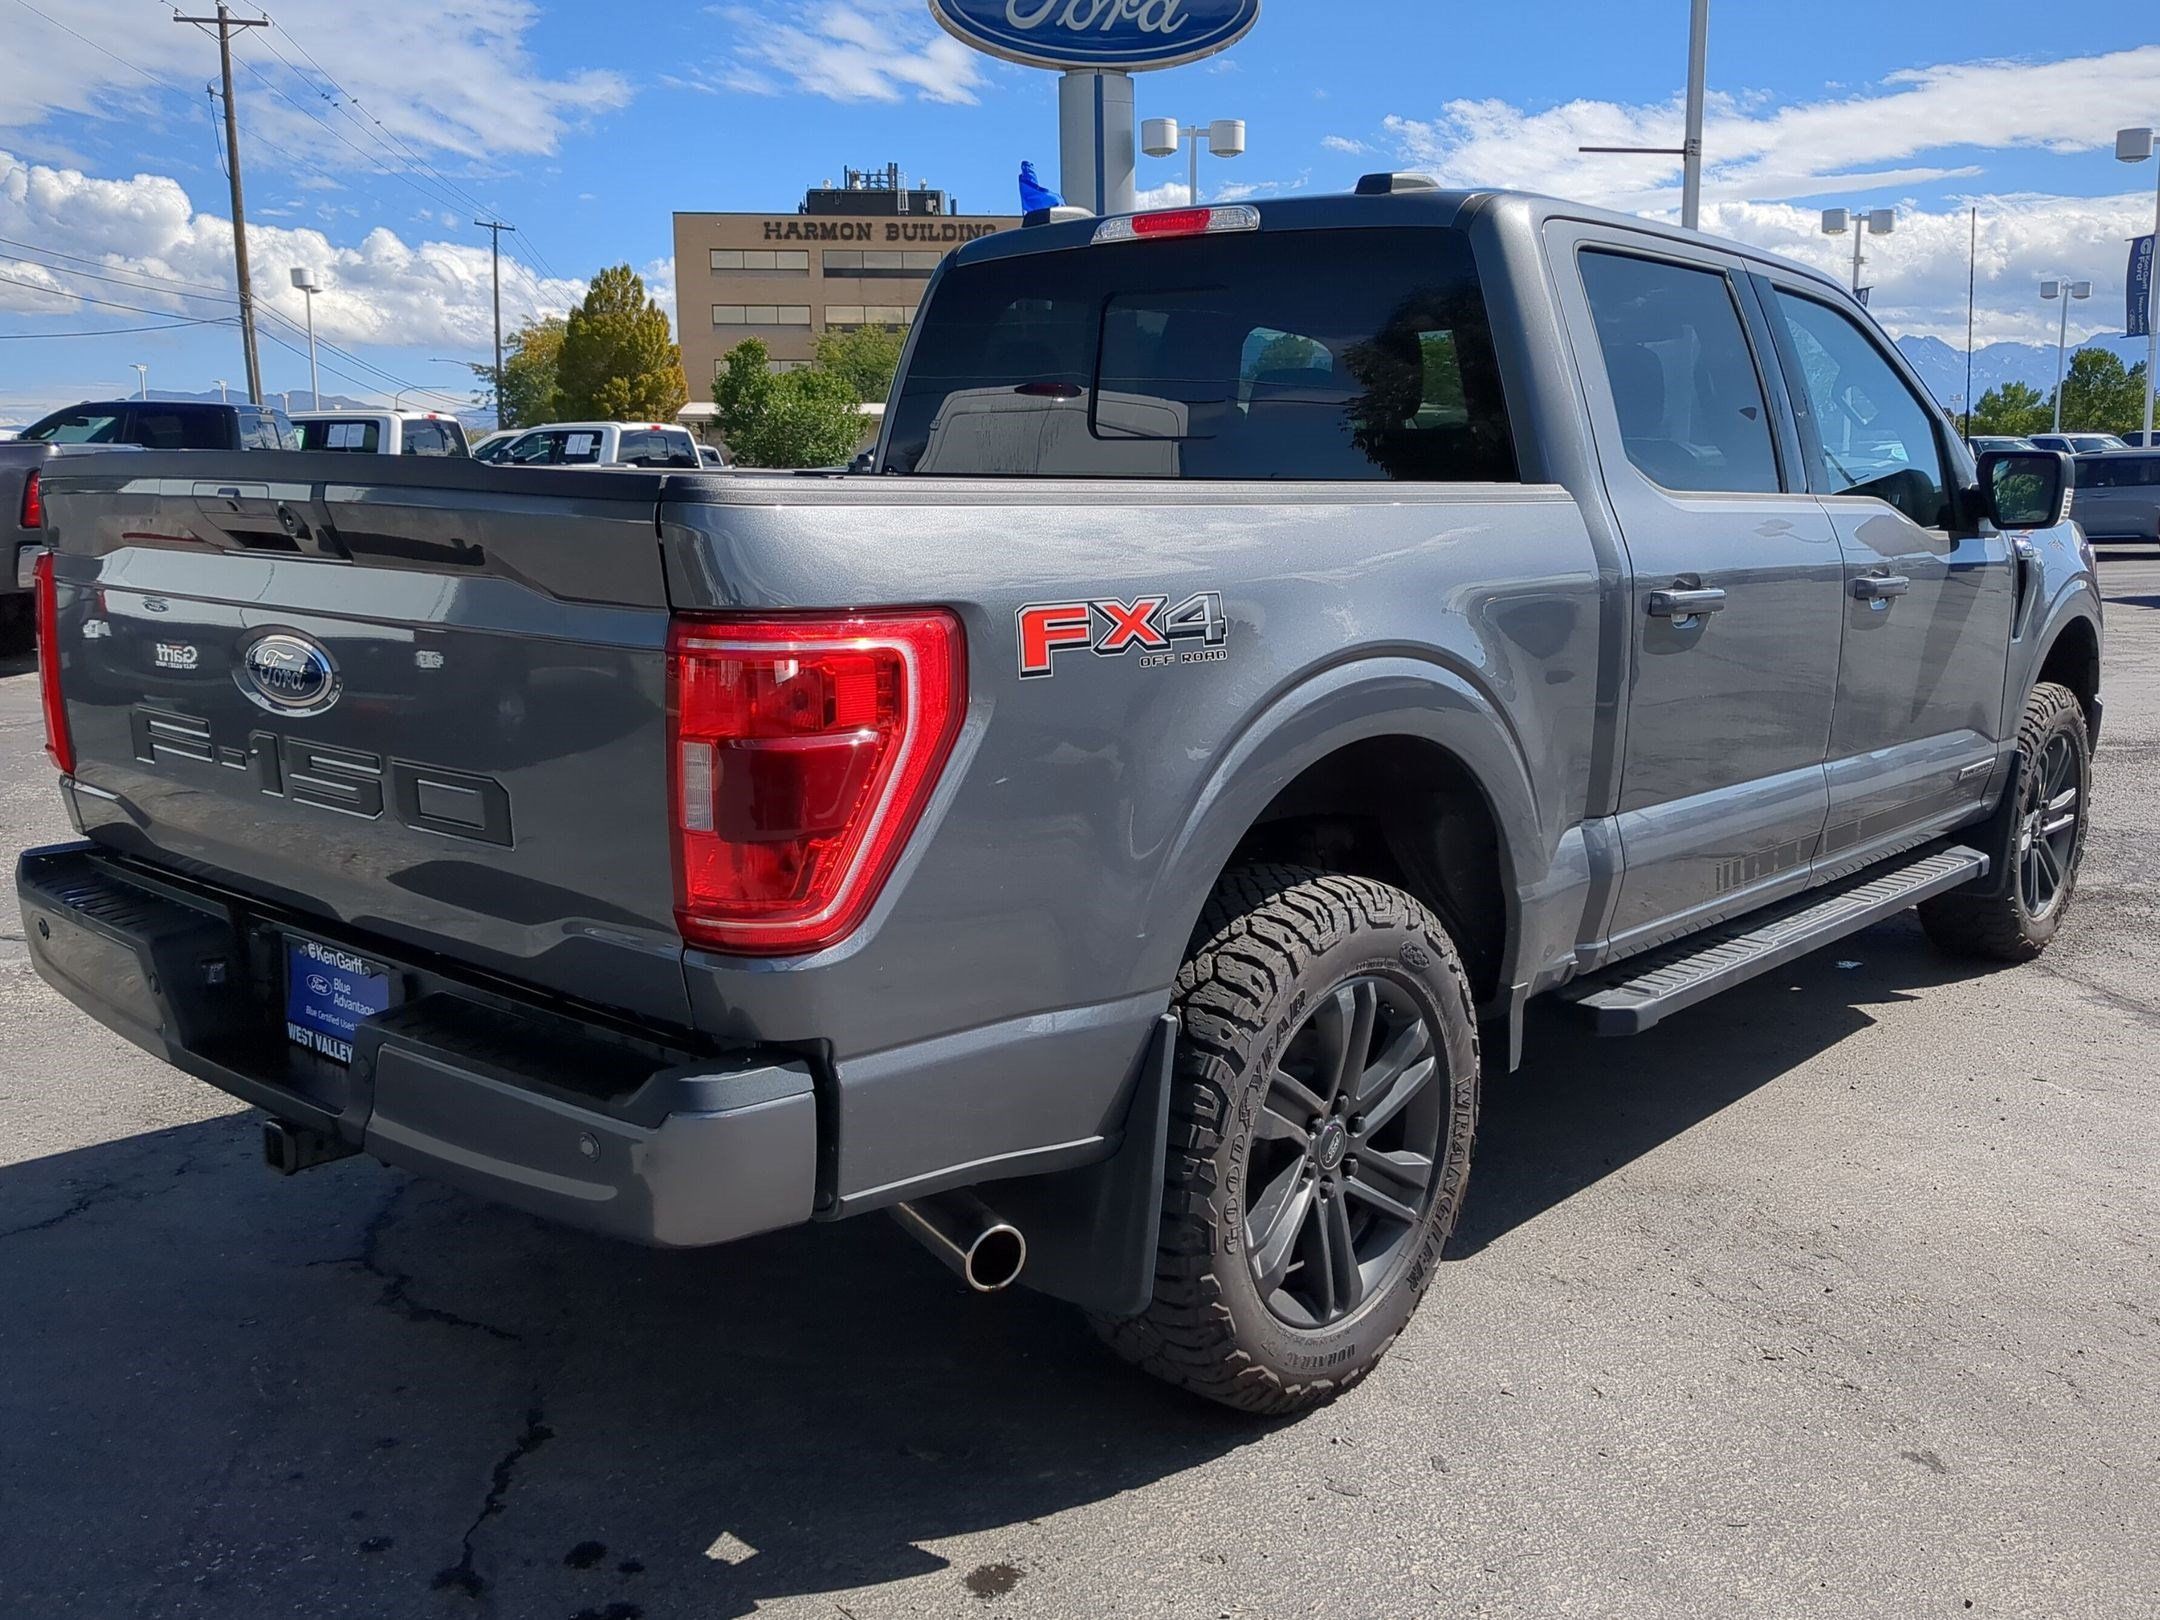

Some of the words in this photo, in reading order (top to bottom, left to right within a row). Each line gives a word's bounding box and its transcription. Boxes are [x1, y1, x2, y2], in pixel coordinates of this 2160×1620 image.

[1005, 0, 1189, 33] ord
[763, 221, 872, 241] HARMON
[885, 223, 996, 242] BUILDING
[2136, 256, 2144, 281] Ford
[1014, 590, 1228, 680] FX4
[259, 649, 306, 691] Ford
[1139, 654, 1175, 668] OFF
[1180, 650, 1227, 664] ROAD
[130, 702, 516, 851] F-150
[311, 976, 329, 994] Ford
[333, 977, 352, 995] Blue
[305, 1005, 318, 1017] Blue
[318, 1008, 340, 1026] Certified
[340, 1018, 355, 1031] Used
[287, 1022, 314, 1048] WEST
[315, 1034, 353, 1064] VALLEY
